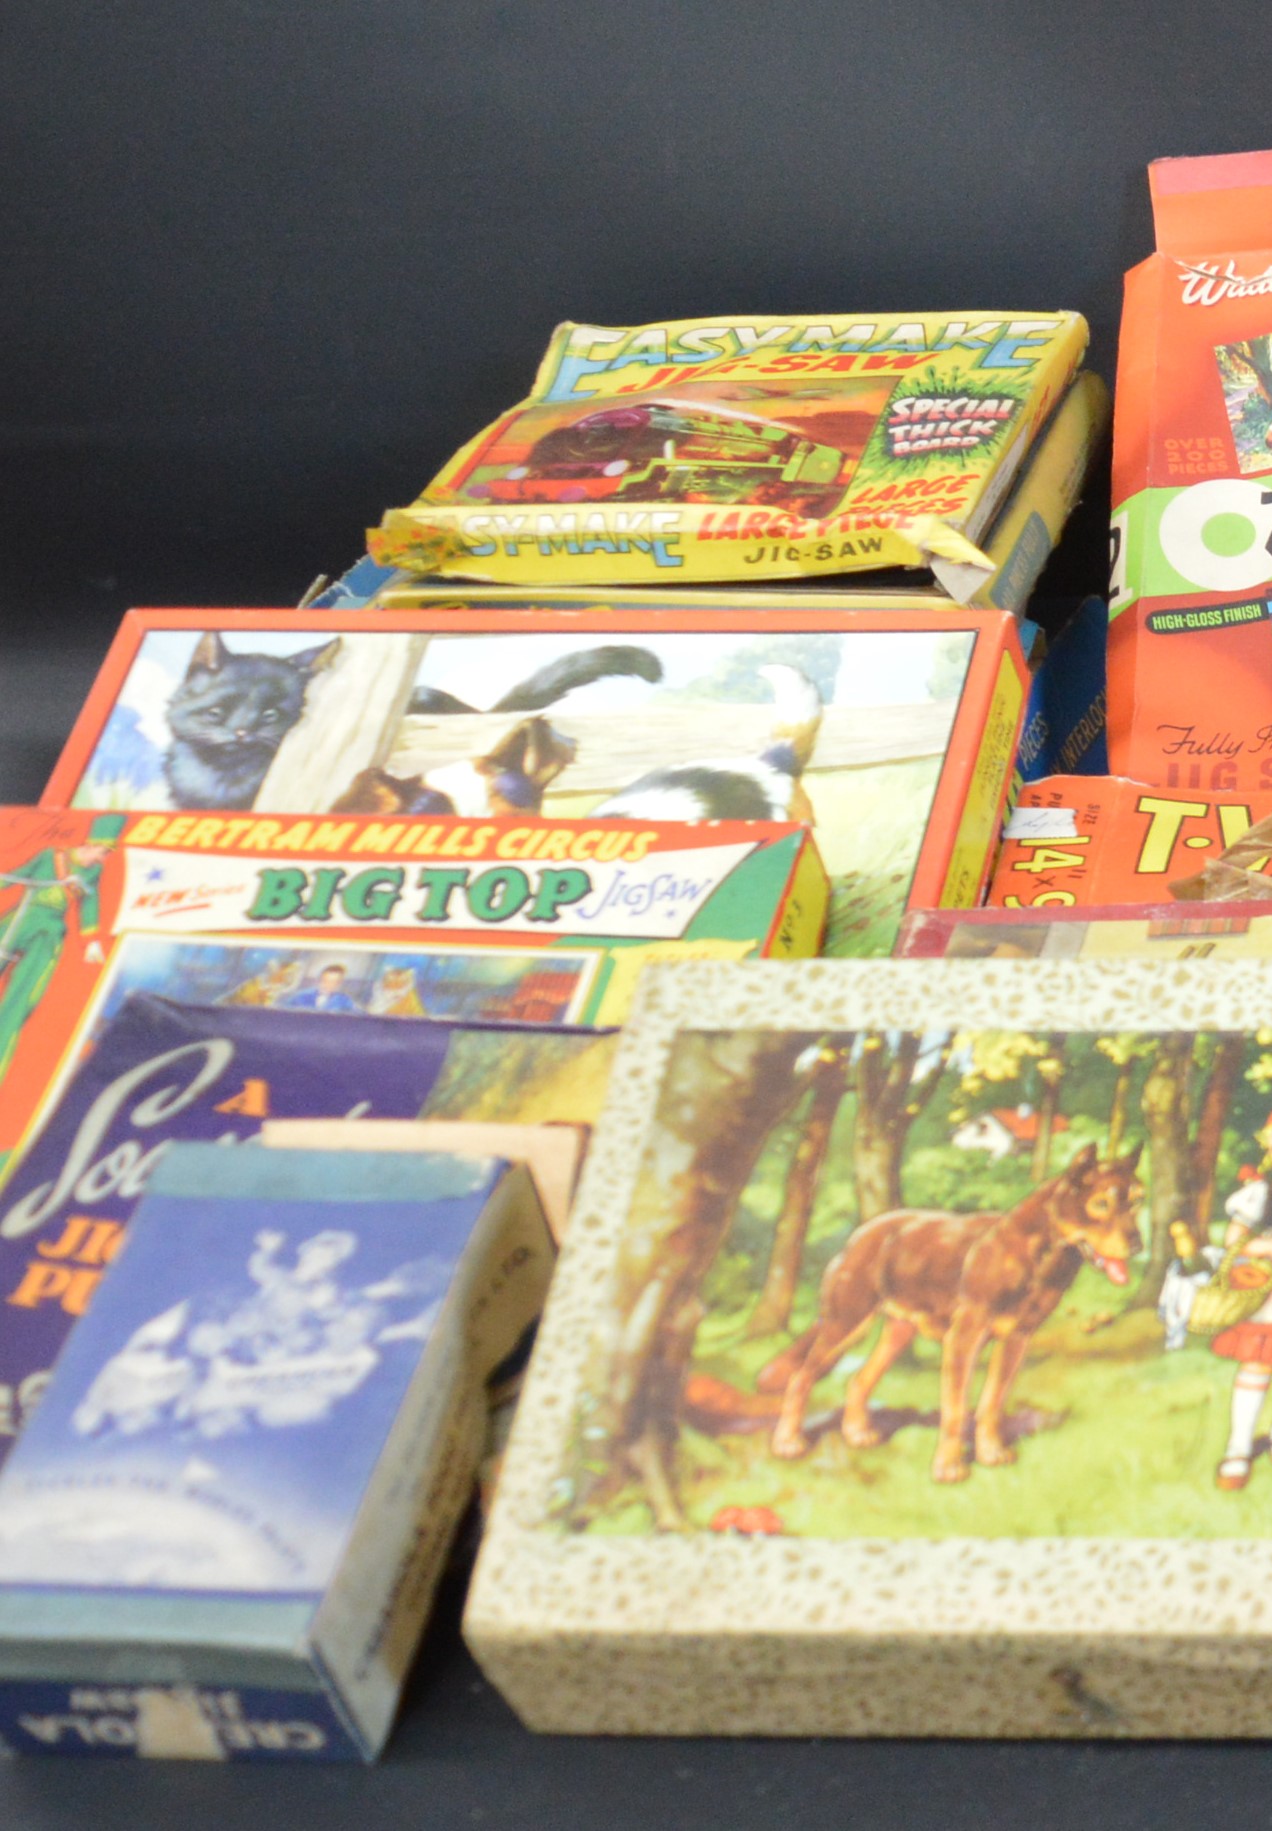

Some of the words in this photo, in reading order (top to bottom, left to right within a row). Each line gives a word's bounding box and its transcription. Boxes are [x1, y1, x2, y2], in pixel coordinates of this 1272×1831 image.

[622, 352, 935, 394] JIG-SAW
[888, 396, 1015, 425] SPECIAL
[888, 419, 998, 443] THICK
[893, 435, 981, 456] BOARD
[1164, 437, 1224, 451] OVER
[1167, 449, 1227, 464] 200
[1168, 461, 1229, 476] PIECES
[850, 474, 981, 505] LARGE
[697, 511, 805, 542] LARGE
[743, 536, 885, 565] JIG-SAW
[1151, 608, 1223, 631] HIGH-GLOSS
[1223, 603, 1263, 622] FINISH
[1155, 724, 1244, 760] Fully
[125, 815, 356, 852] BERTRAM
[348, 821, 497, 858] MILLS
[495, 825, 659, 863] CIRCUS
[131, 888, 192, 910] NEW
[244, 866, 406, 922] BIG
[415, 865, 594, 923] TOP
[576, 868, 712, 920] JIGSAW
[213, 1078, 271, 1118] A
